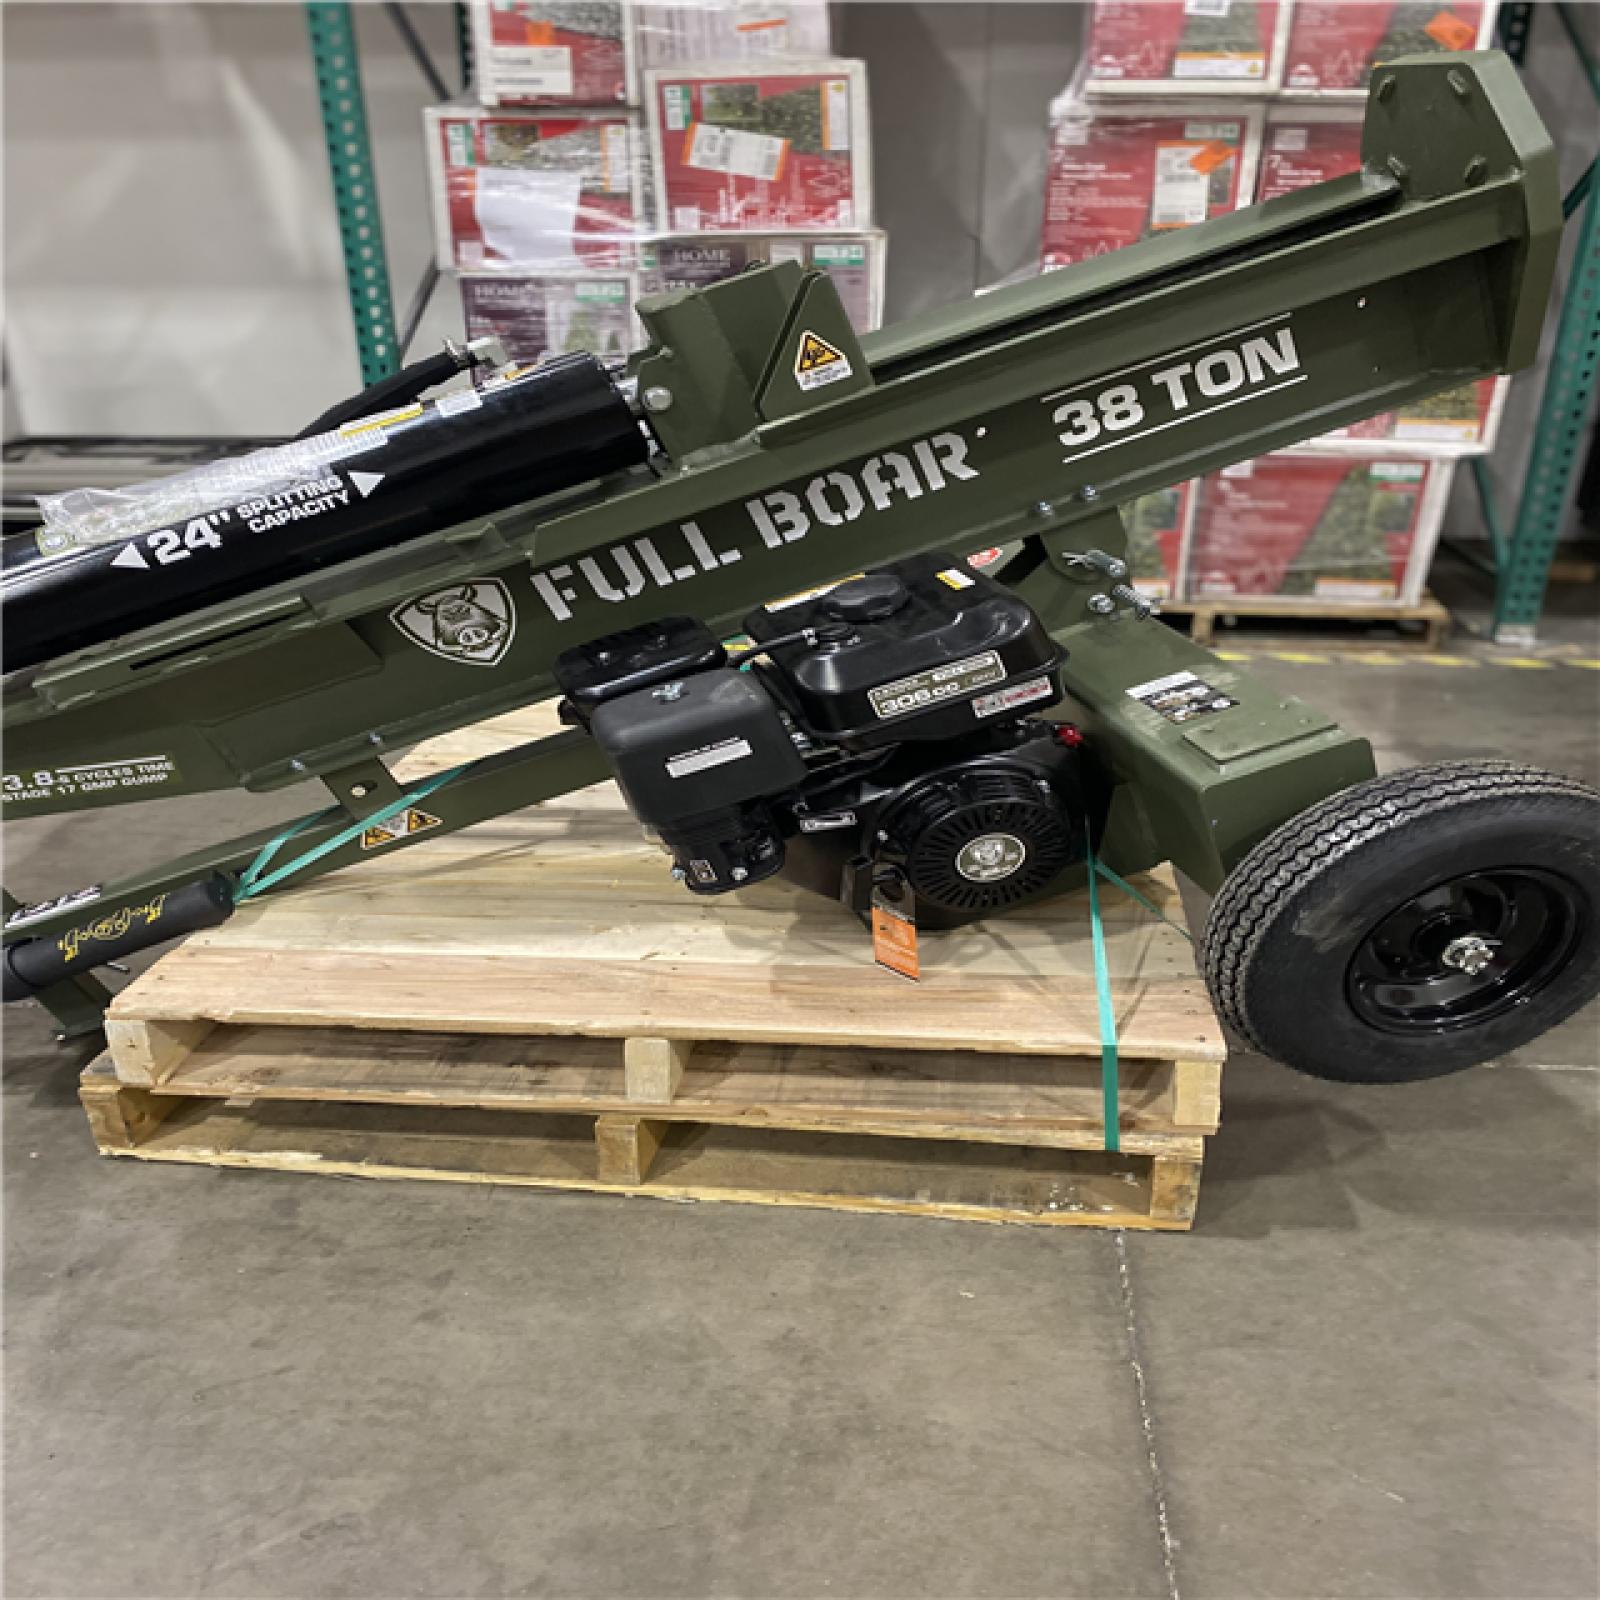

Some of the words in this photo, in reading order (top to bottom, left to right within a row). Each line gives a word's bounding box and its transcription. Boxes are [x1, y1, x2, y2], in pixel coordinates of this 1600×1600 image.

[1055, 384, 1143, 446] 38
[1151, 329, 1300, 411] TON
[147, 509, 231, 566] 24"
[237, 474, 343, 519] SPLITTING
[248, 489, 349, 533] CAPACITY
[530, 523, 742, 621] FULL
[746, 432, 980, 549] BOAR
